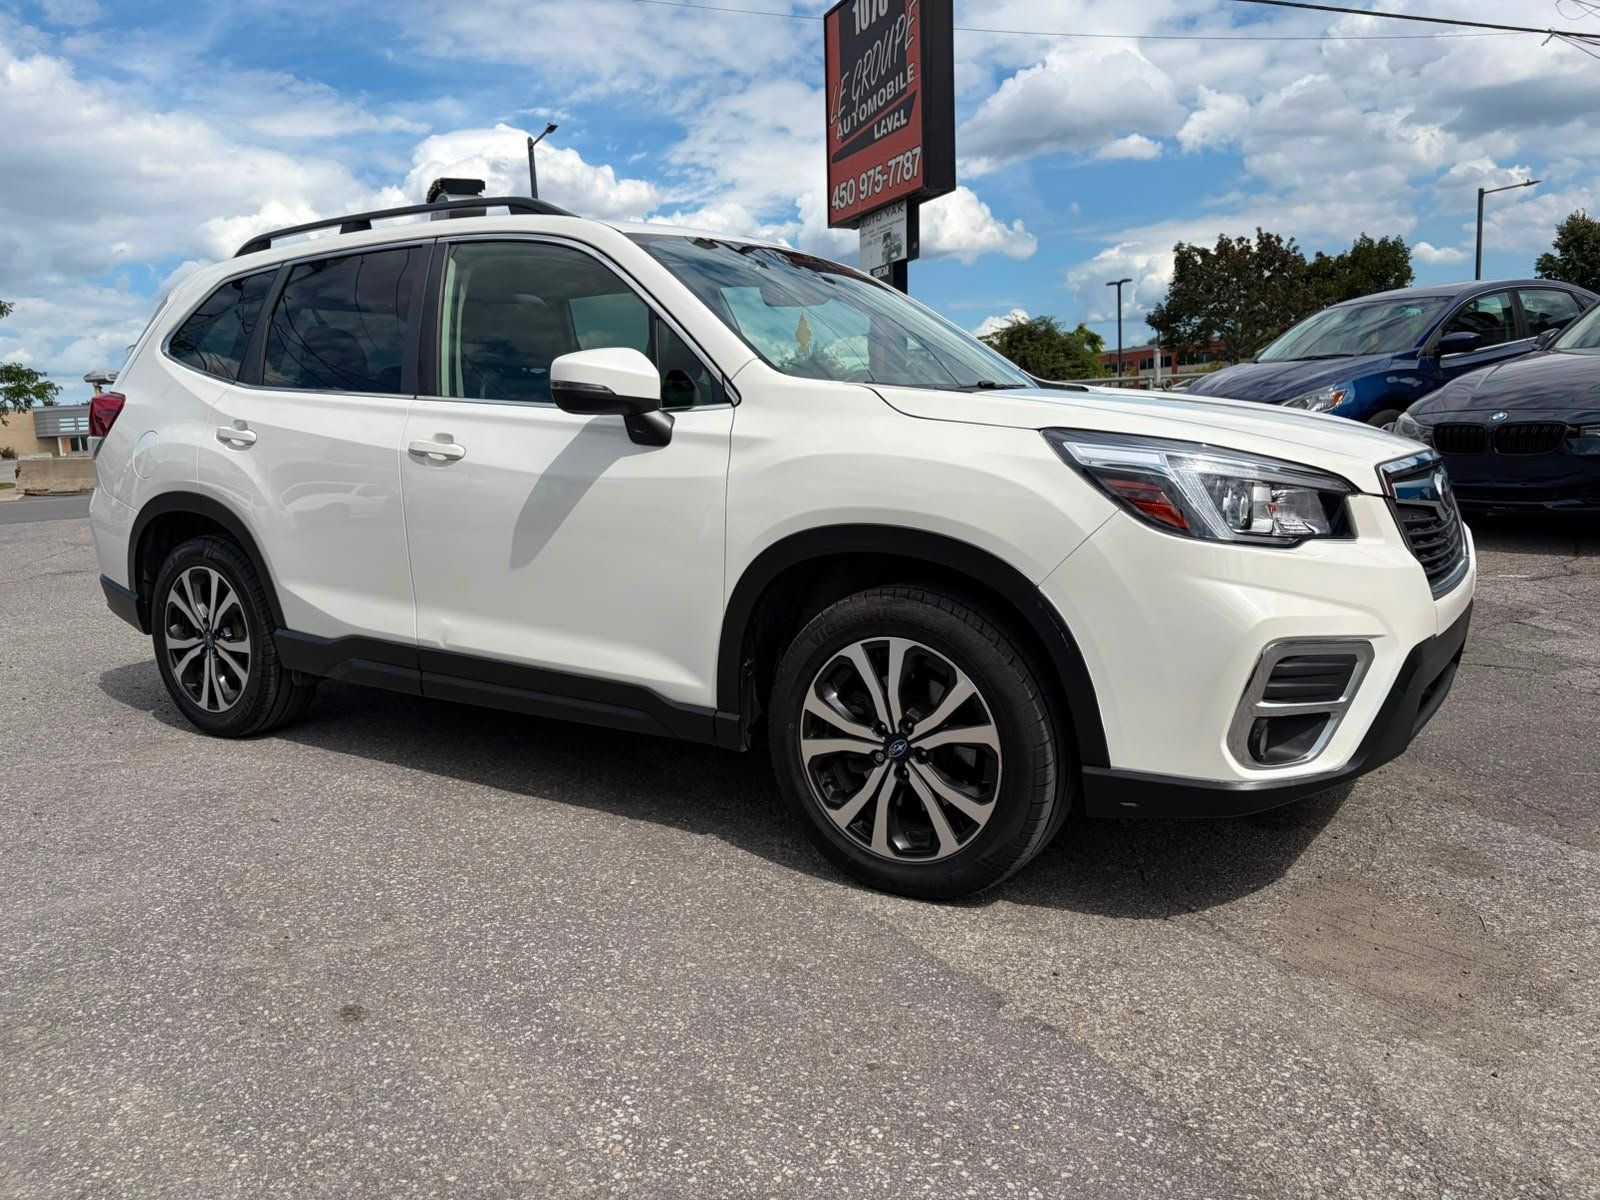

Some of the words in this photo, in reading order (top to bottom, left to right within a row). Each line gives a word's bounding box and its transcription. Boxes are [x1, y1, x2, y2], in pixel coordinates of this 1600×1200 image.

[830, 71, 849, 125] LE
[851, 0, 917, 113] GROUPE
[836, 63, 915, 140] AUTOMOBILE
[874, 109, 908, 140] LAVAL
[832, 178, 856, 211] 450
[859, 145, 922, 200] 975-7787
